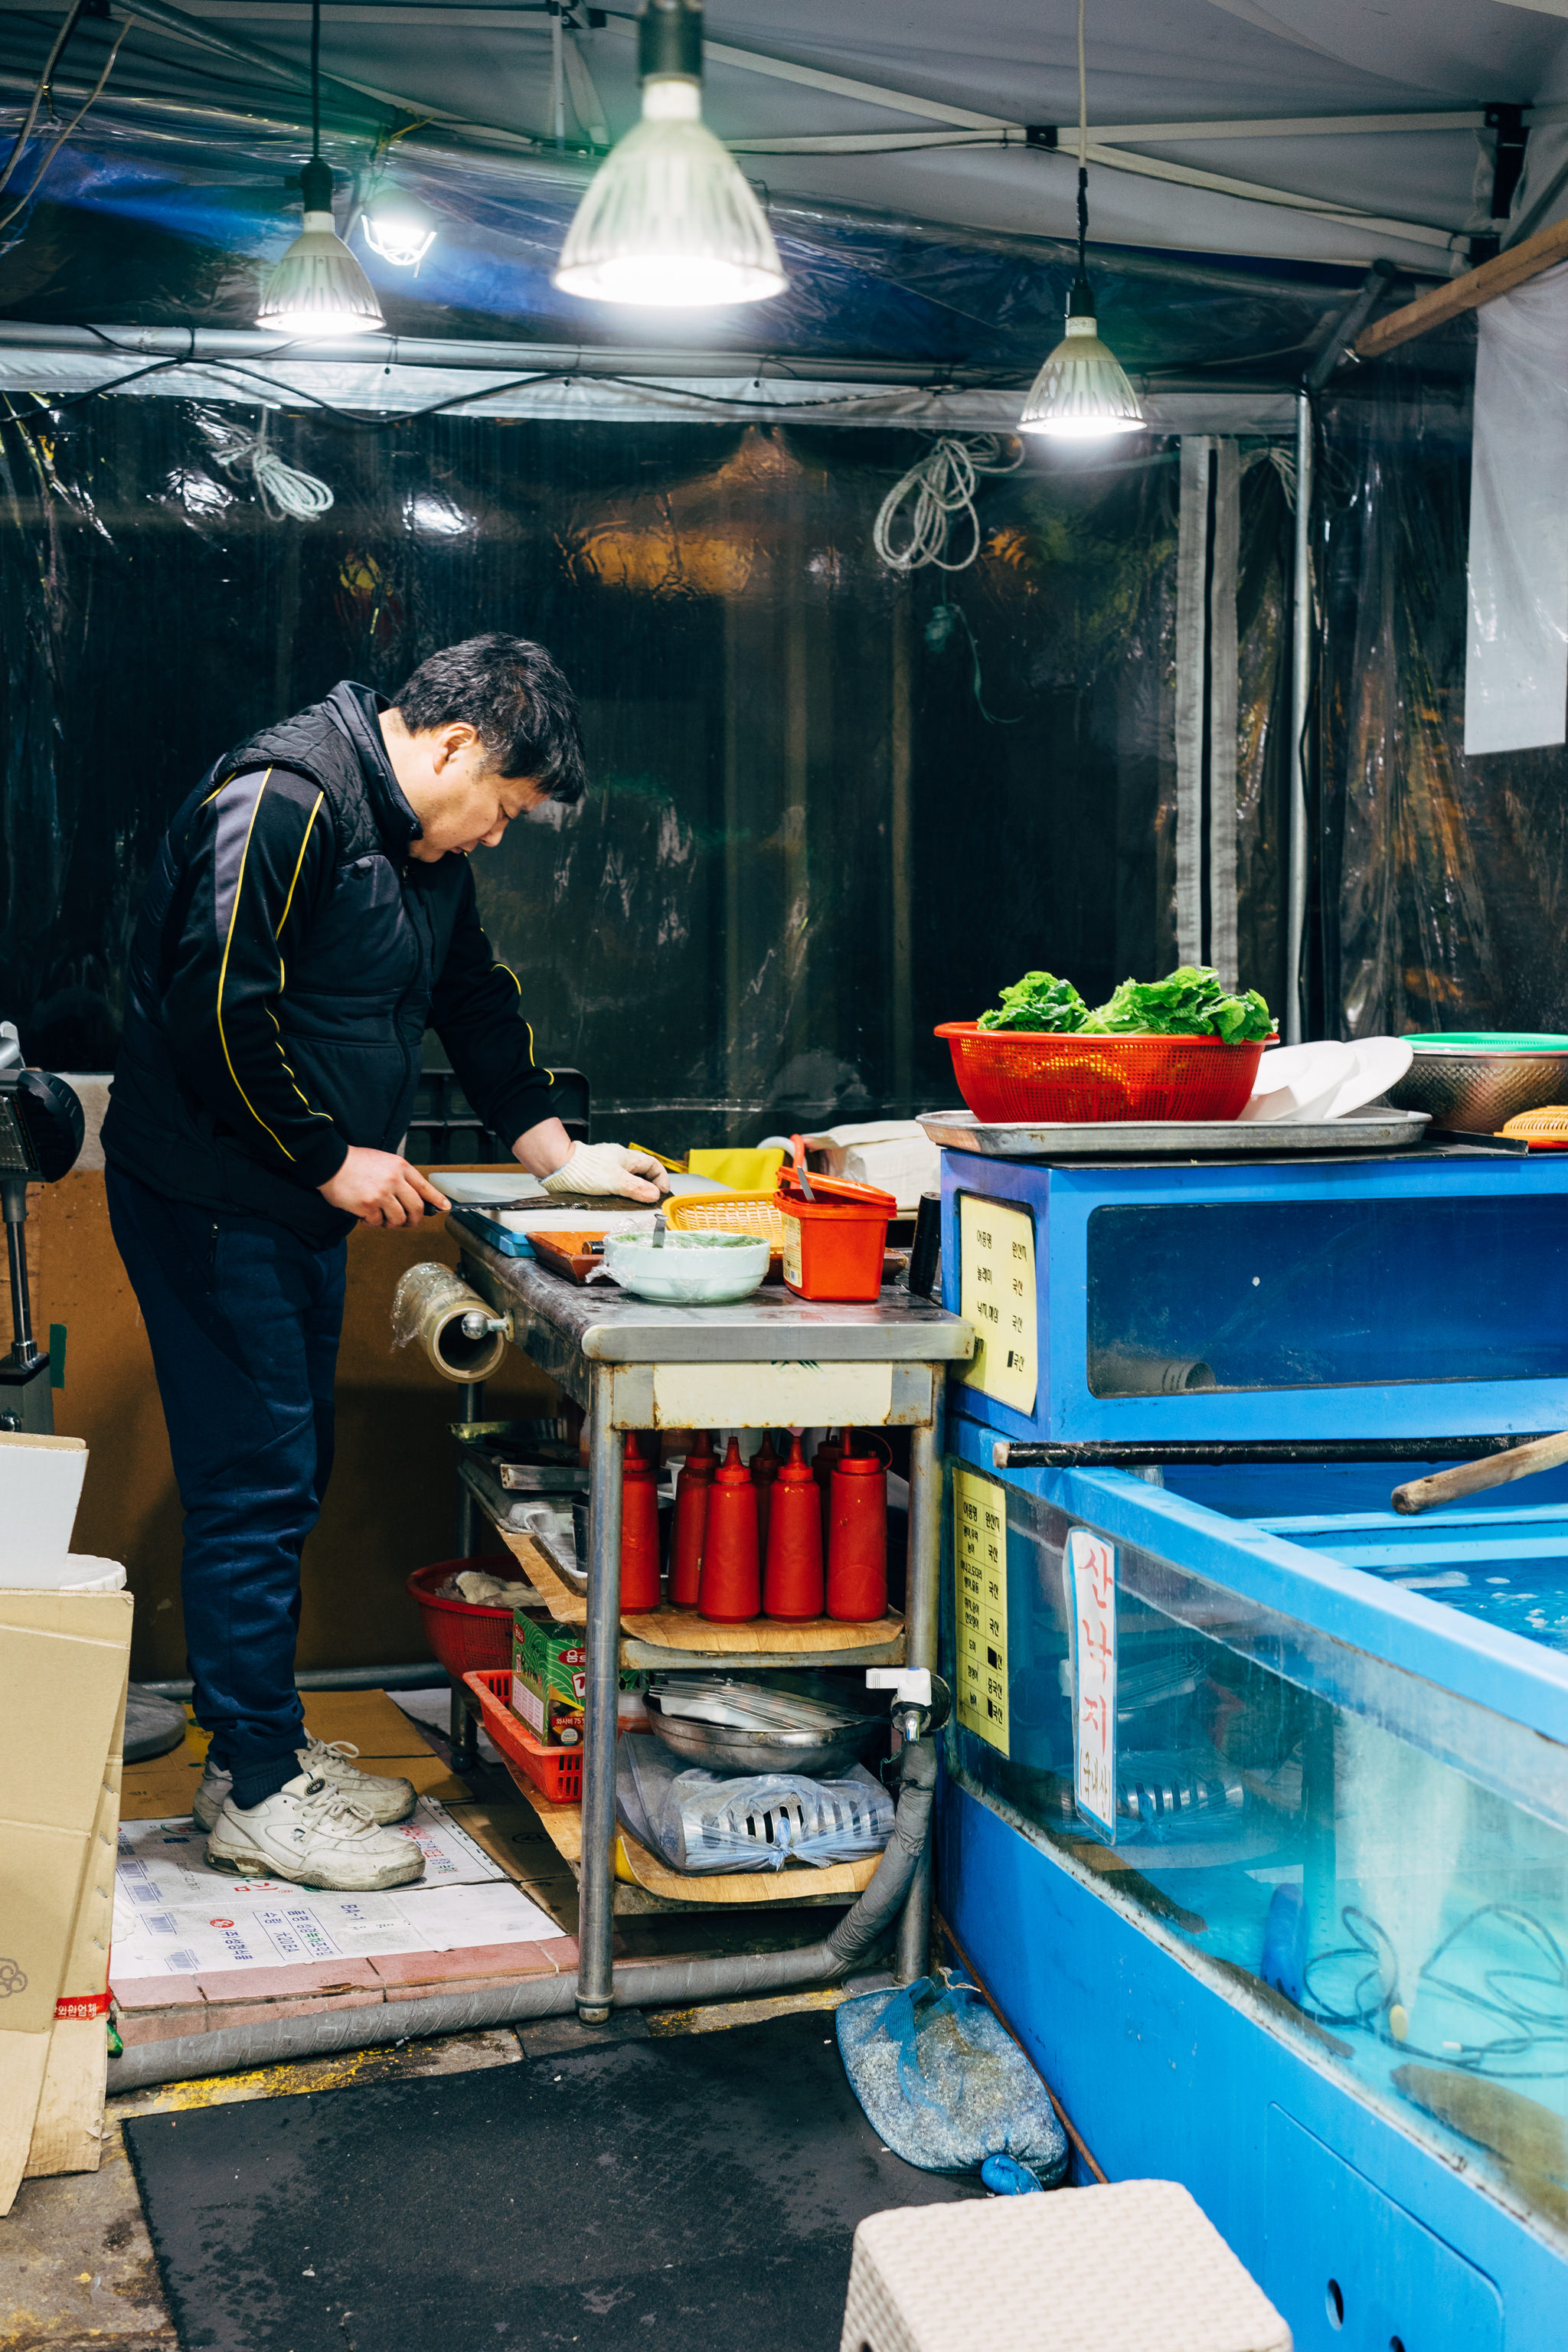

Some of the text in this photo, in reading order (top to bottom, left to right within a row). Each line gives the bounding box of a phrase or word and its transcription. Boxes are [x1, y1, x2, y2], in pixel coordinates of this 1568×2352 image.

[977, 1229, 992, 1250] 어종명
[1012, 1241, 1027, 1262] 원산지
[1012, 1278, 1023, 1296] 국산
[1012, 1315, 1023, 1333] 국산
[963, 1501, 978, 1522] 어종명
[985, 1511, 1000, 1532] 원산지
[988, 1544, 998, 1563] 국산
[988, 1580, 998, 1600] 국산
[989, 1618, 999, 1637] 국산
[1078, 1547, 1112, 1757] 산낙지
[988, 1677, 1002, 1700] 중국산
[263, 1912, 283, 1924] 수량
[287, 1909, 311, 1922] 품명
[340, 1904, 366, 1920] BA-1
[55, 2003, 96, 2017] 회원업체
